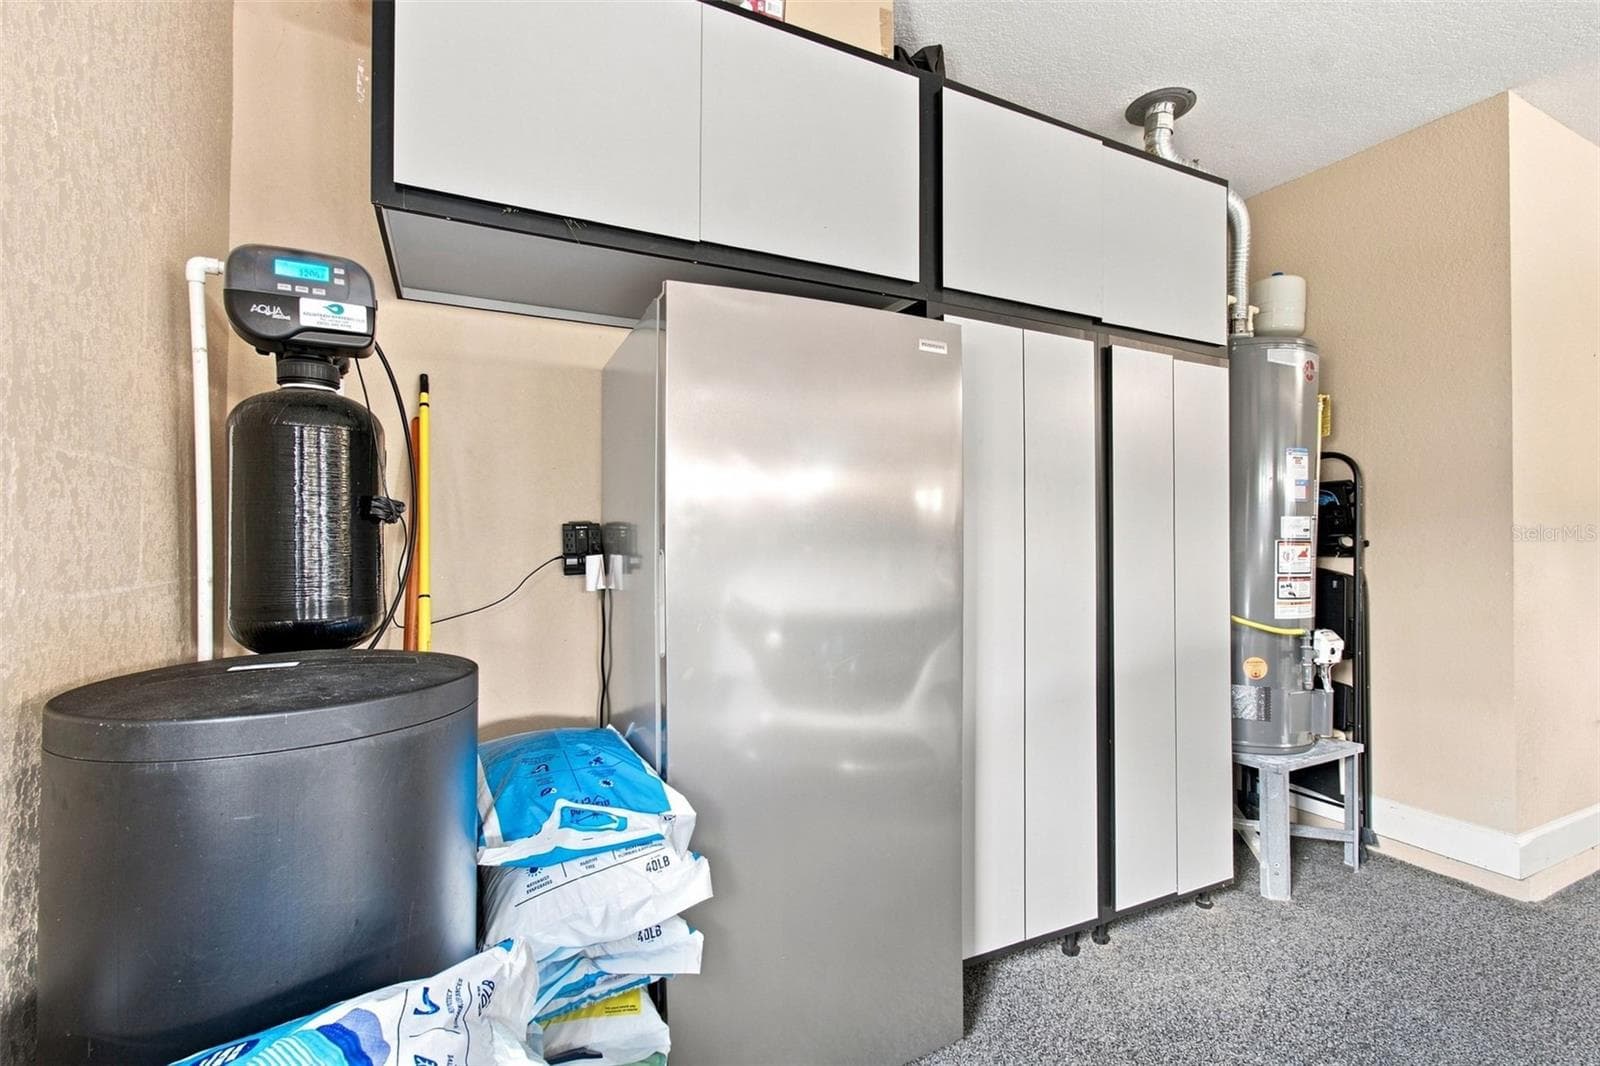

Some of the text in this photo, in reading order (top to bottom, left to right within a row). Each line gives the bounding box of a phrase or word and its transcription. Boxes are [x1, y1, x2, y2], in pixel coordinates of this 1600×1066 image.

[250, 304, 283, 316] AQUA
[646, 855, 671, 873] 40LB
[637, 924, 662, 942] 40LB
